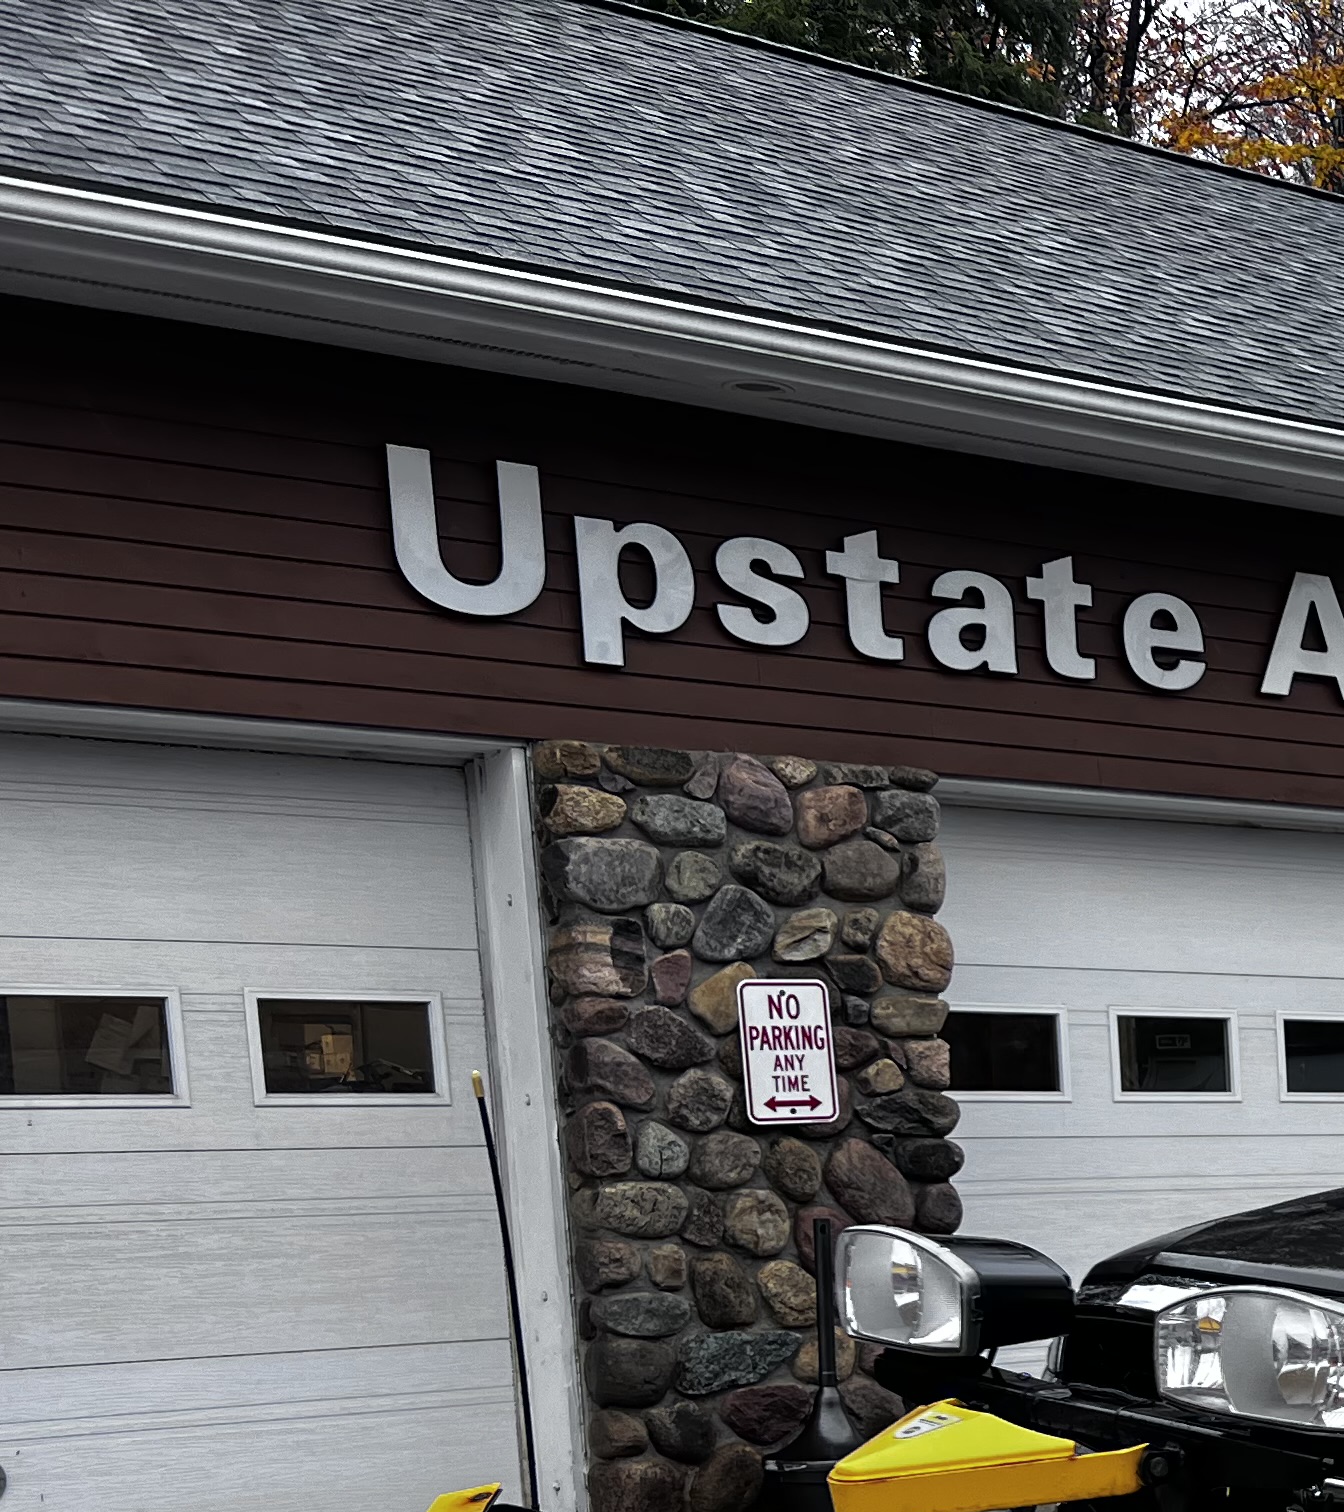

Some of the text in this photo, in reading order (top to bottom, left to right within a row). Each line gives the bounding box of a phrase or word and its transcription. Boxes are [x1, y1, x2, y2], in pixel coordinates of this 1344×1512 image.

[385, 442, 1208, 690] Upstate
[767, 993, 801, 1020] NO
[748, 1024, 825, 1051] PARKING
[773, 1054, 805, 1072] ANY
[771, 1074, 811, 1092] TIME
